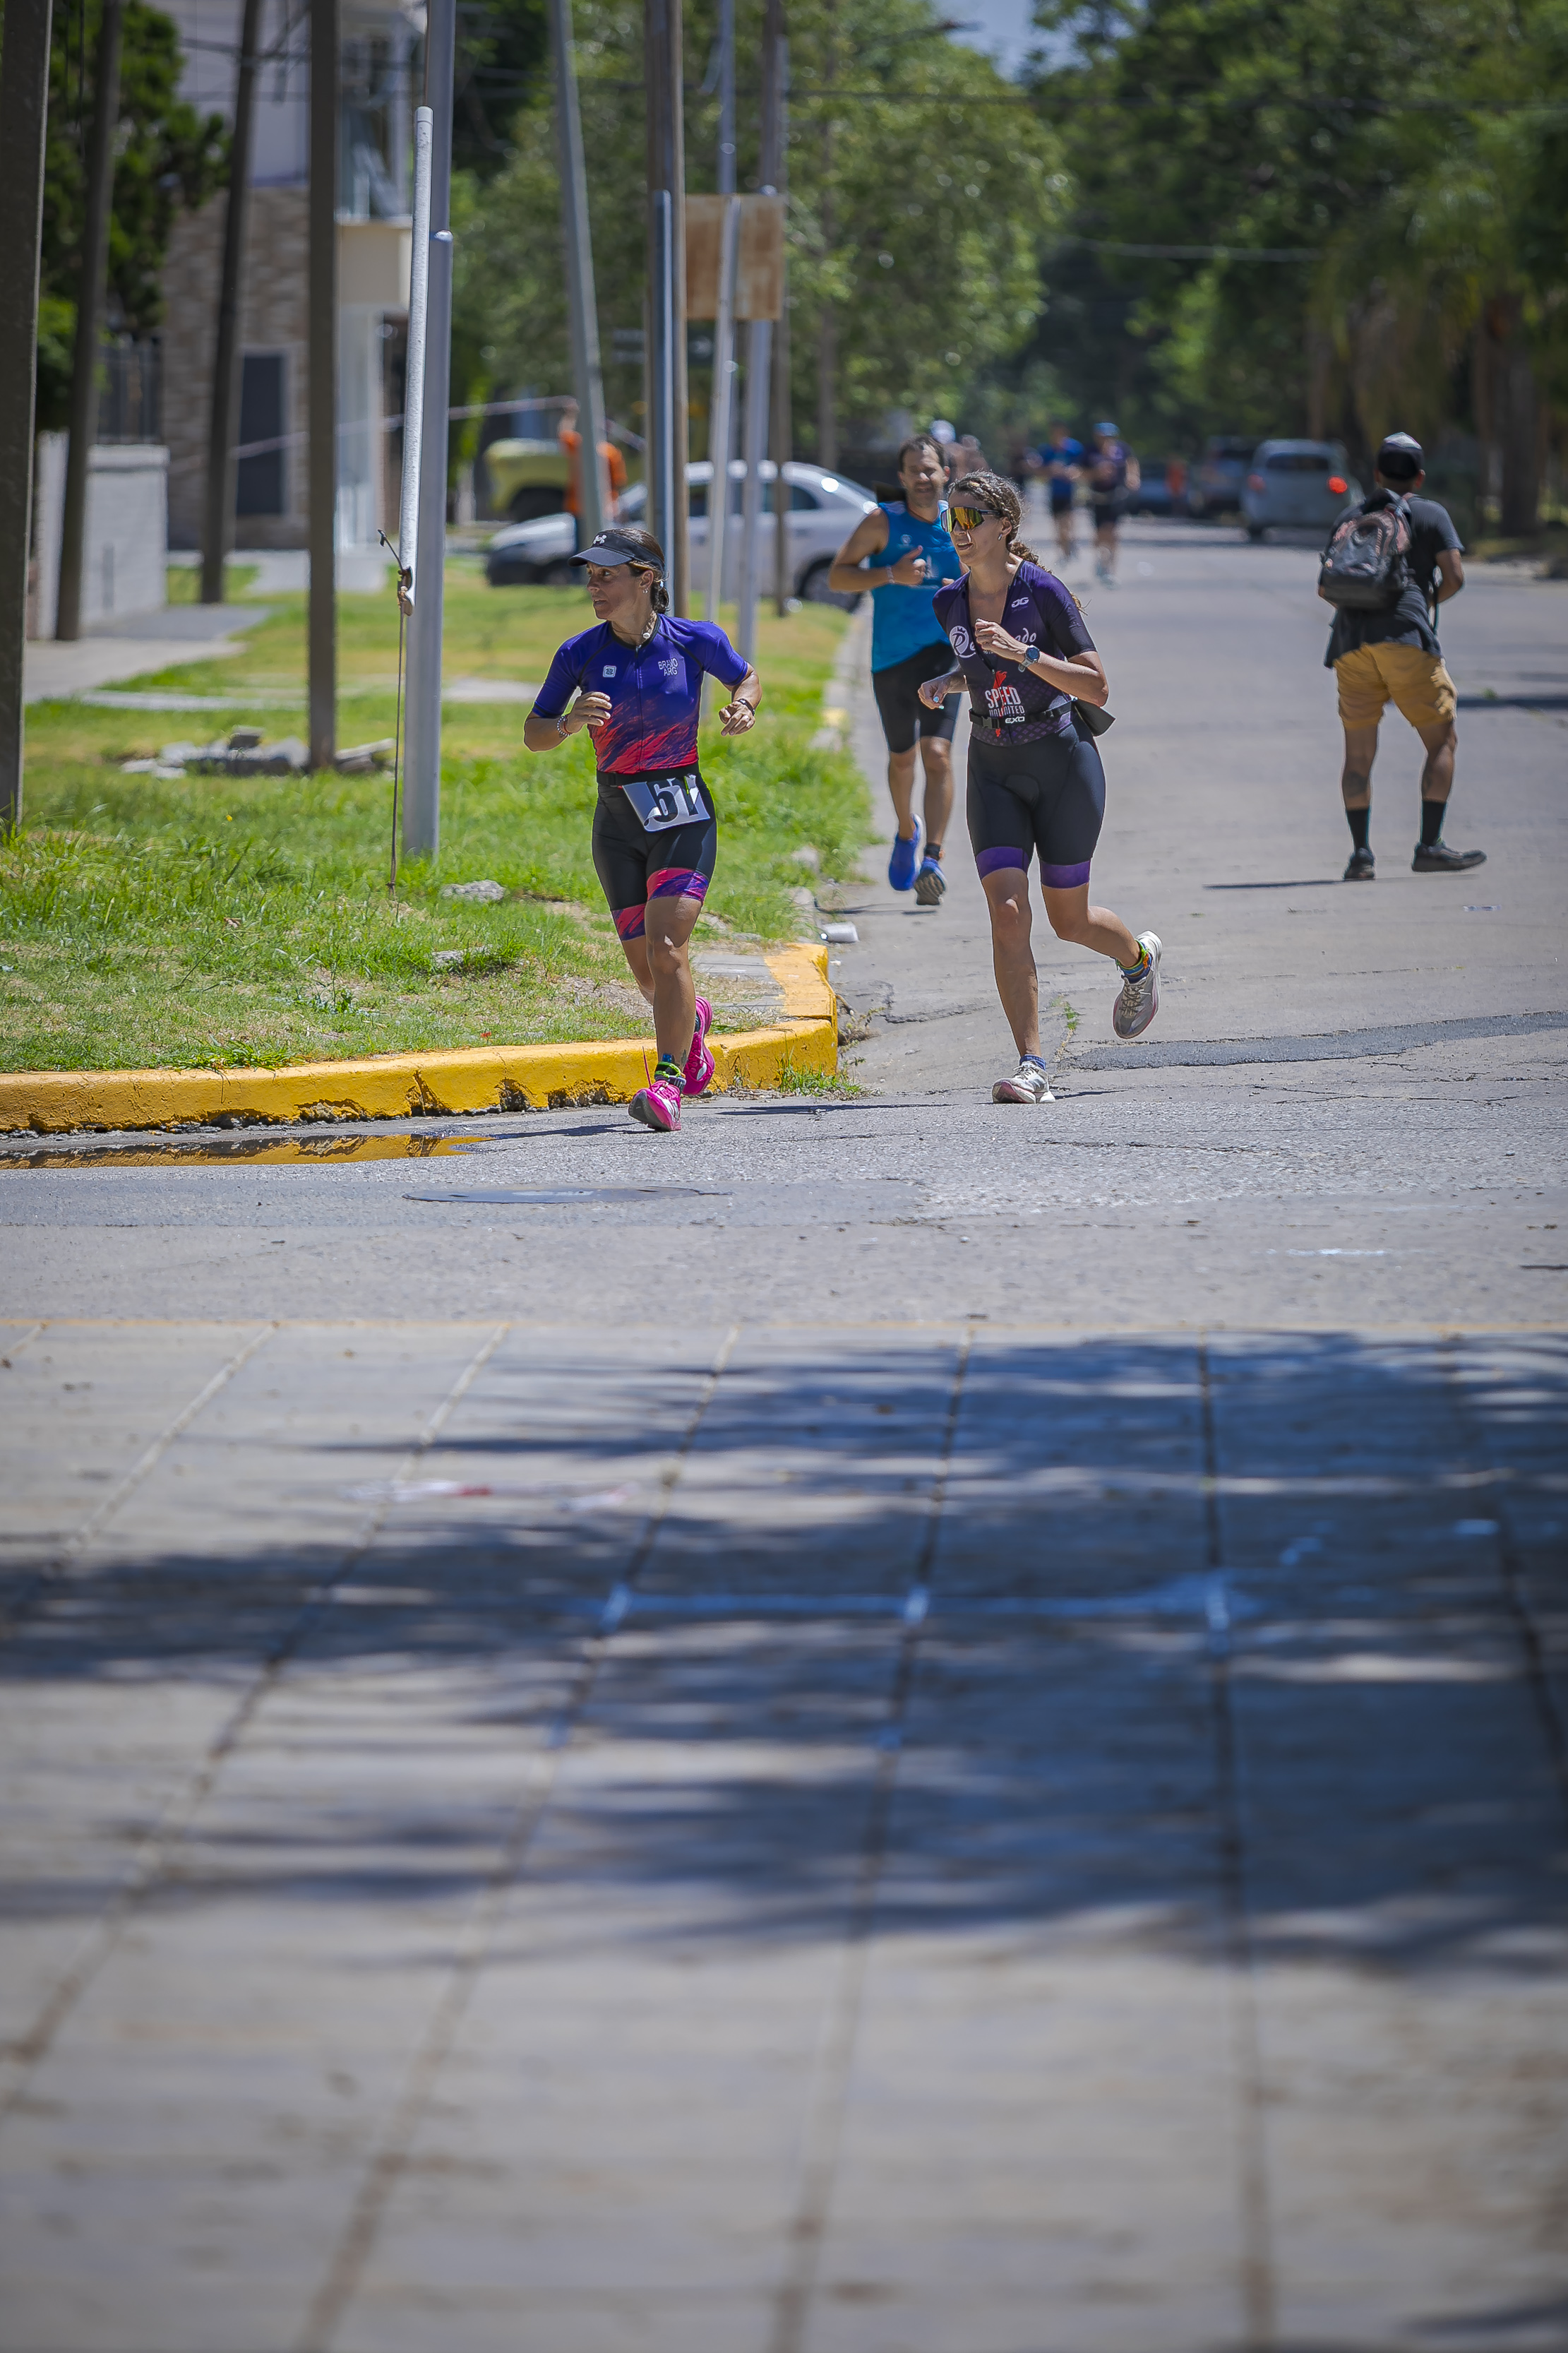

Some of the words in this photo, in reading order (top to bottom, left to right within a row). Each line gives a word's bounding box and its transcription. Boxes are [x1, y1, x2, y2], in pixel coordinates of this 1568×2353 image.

[657, 657, 678, 670] BRAVO
[664, 667, 678, 677] ARG
[985, 686, 1022, 708] SPEED
[989, 705, 1025, 717] UNLIMITED
